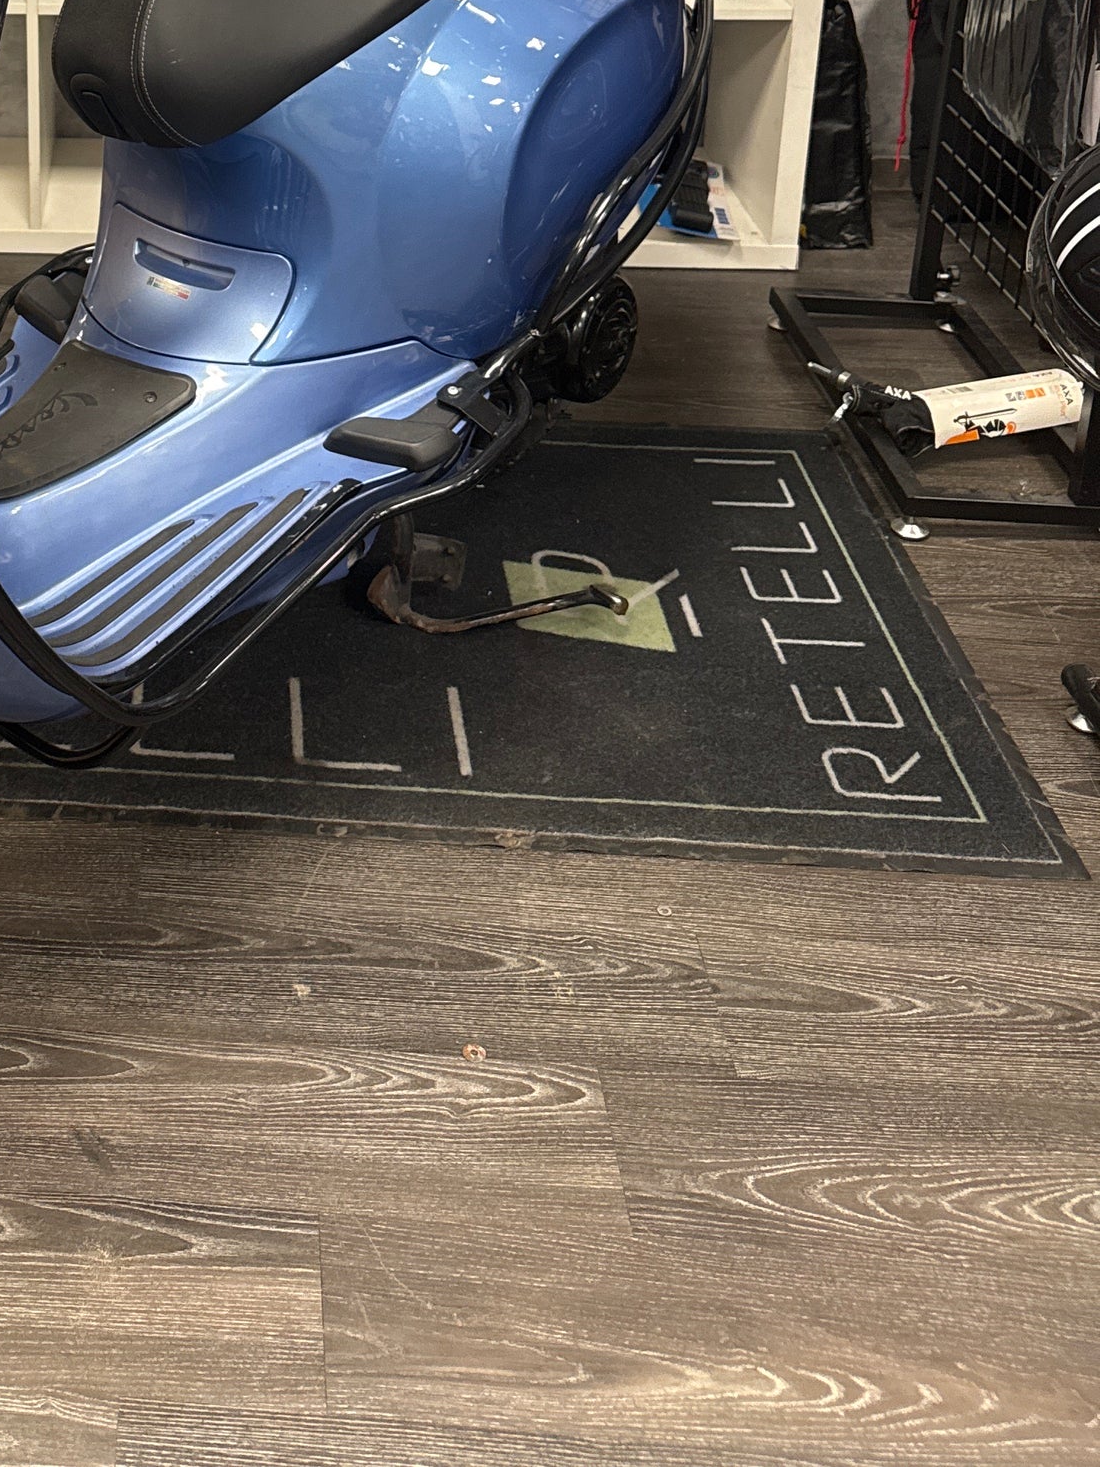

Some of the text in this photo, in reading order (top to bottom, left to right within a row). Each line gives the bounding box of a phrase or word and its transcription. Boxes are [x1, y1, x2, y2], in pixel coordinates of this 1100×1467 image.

[884, 385, 911, 401] AXA
[1060, 384, 1074, 405] AXA
[693, 454, 943, 804] RETELLI
